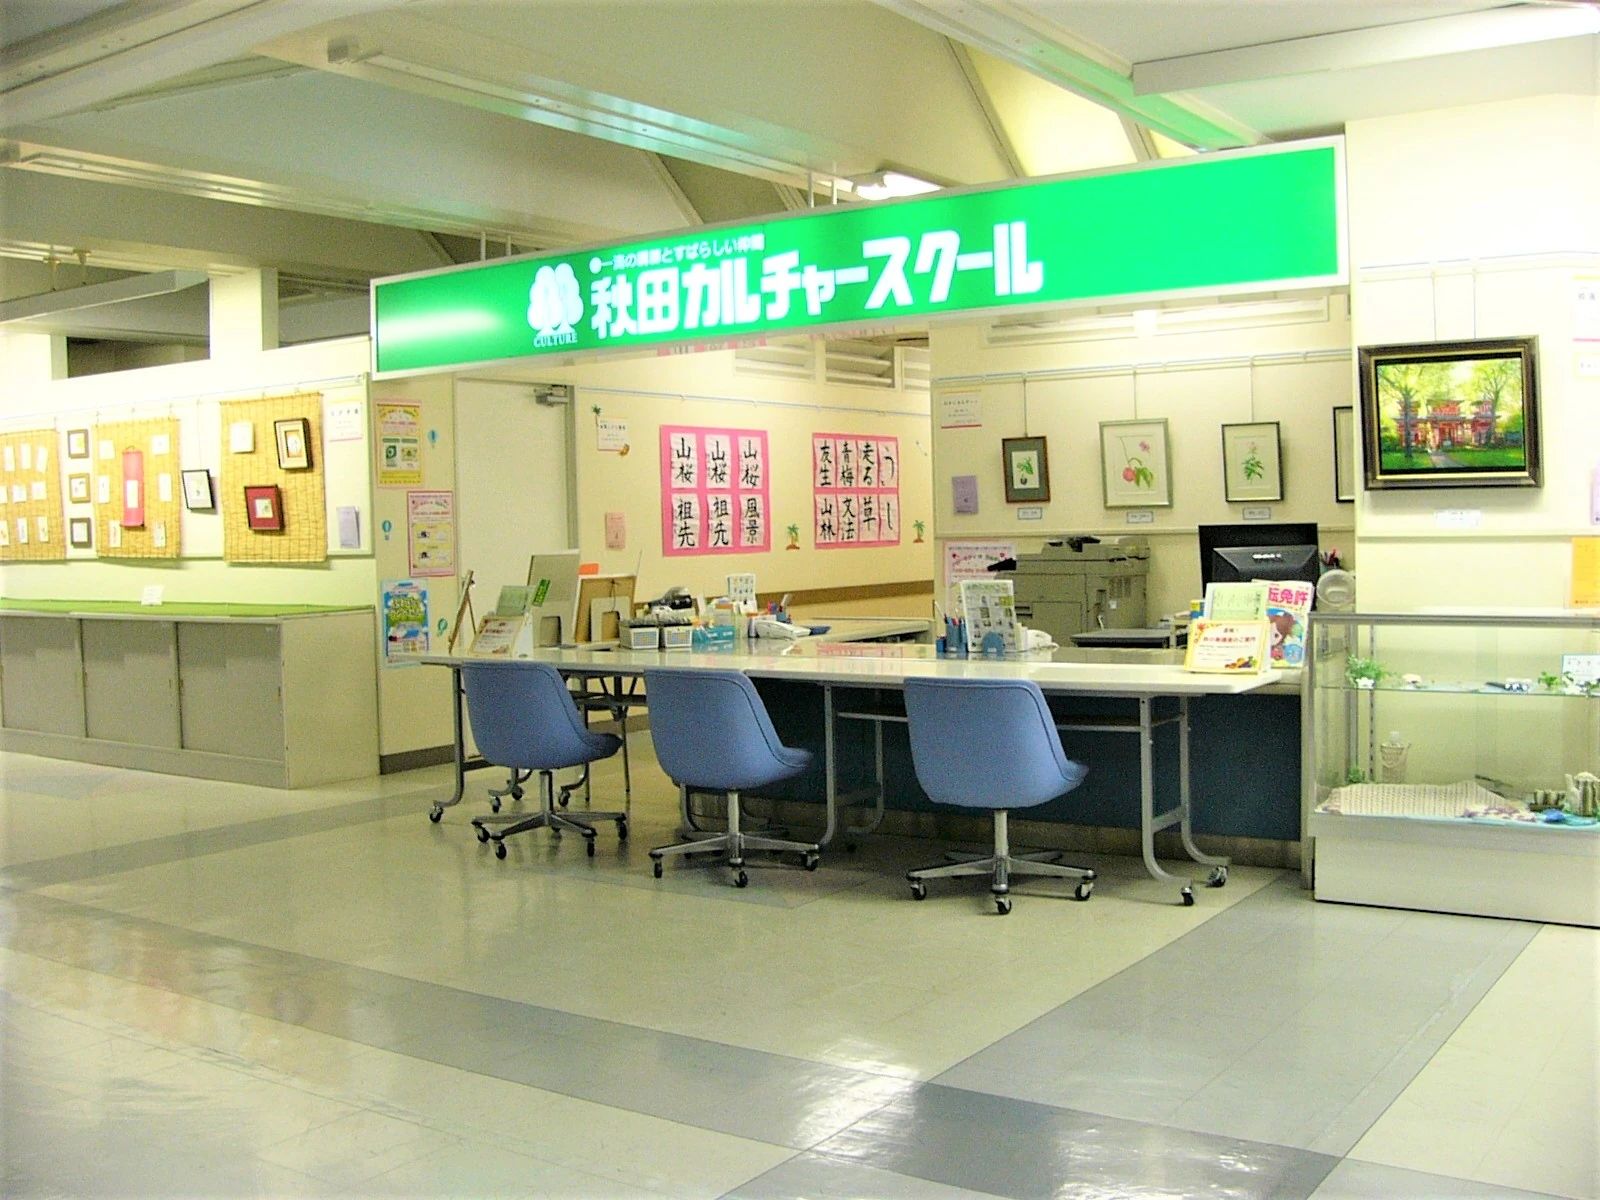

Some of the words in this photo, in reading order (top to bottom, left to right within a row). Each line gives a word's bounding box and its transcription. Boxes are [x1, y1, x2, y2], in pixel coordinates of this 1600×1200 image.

[591, 221, 1043, 338] 秋田カルチャースクール
[533, 331, 579, 348] CULTURE
[675, 437, 695, 485] 山桜
[710, 440, 728, 485] 山桜
[742, 439, 761, 488] 山桜
[677, 497, 696, 548] 祖先
[713, 496, 730, 546] 祖先
[744, 498, 761, 545] 風景
[819, 497, 836, 541] 山林
[841, 497, 856, 541] 文法
[862, 496, 877, 532] 草
